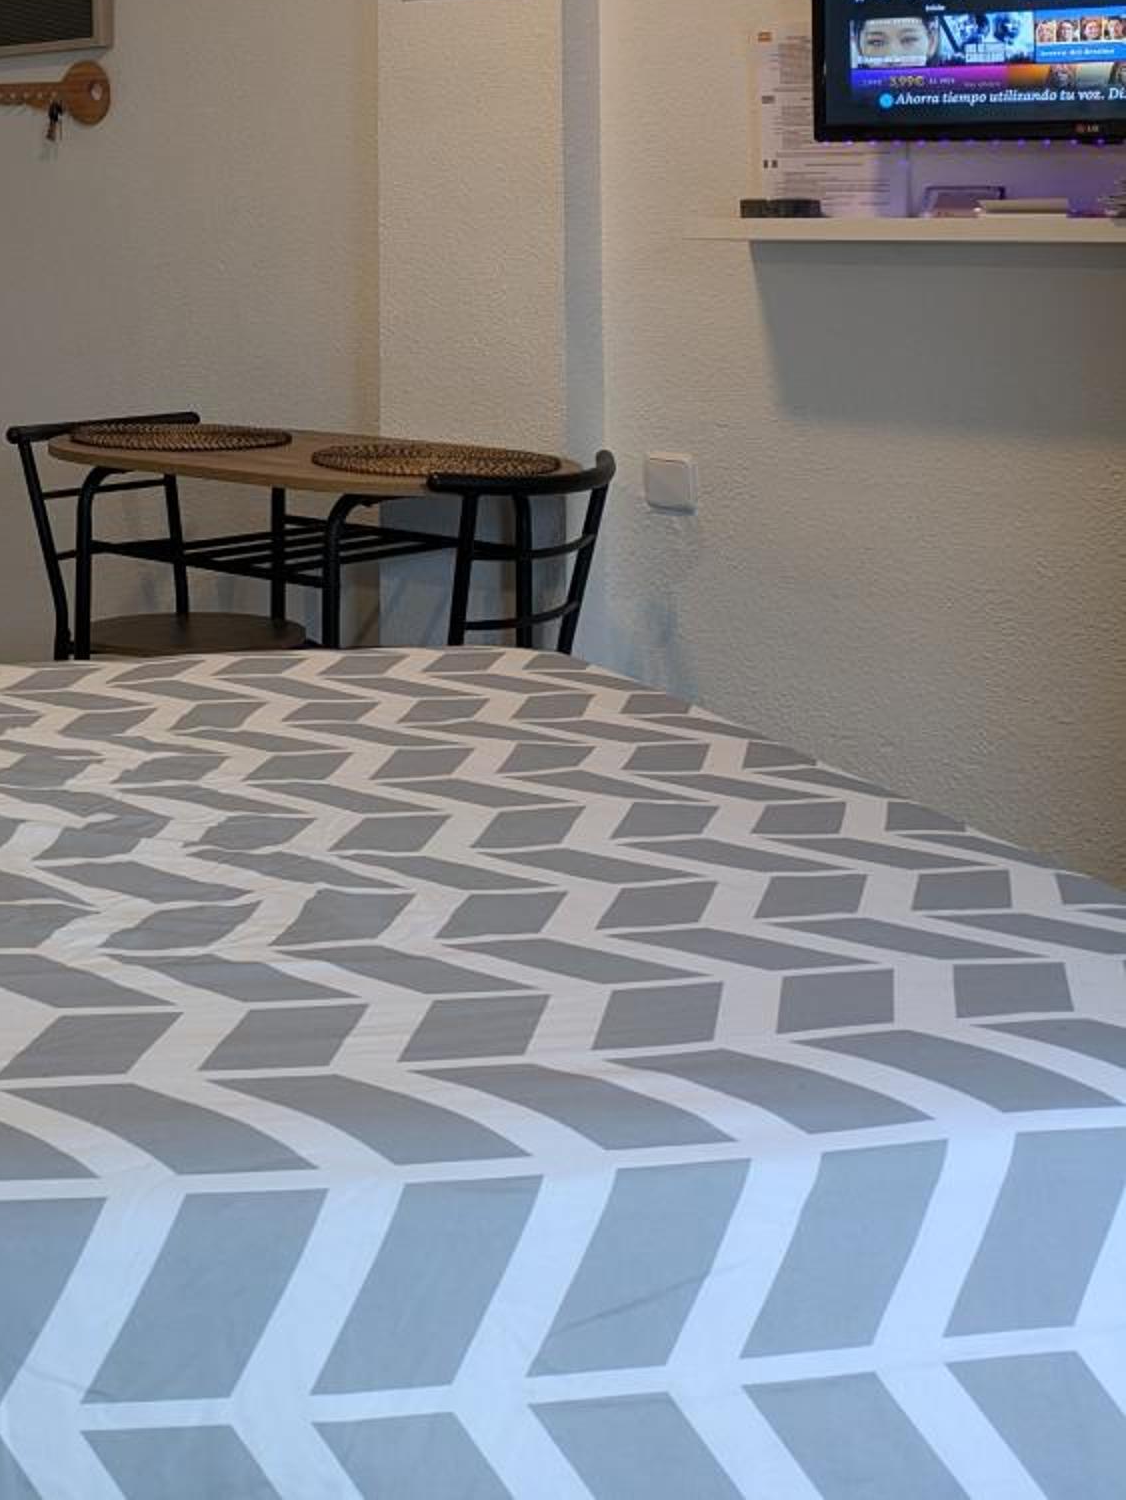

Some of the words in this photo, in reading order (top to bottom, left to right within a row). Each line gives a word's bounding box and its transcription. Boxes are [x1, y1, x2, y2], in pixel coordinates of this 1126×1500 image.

[895, 88, 940, 105] Ahorra
[942, 86, 987, 106] tiempo
[989, 84, 1057, 103] utilizando
[1059, 86, 1076, 101] tu
